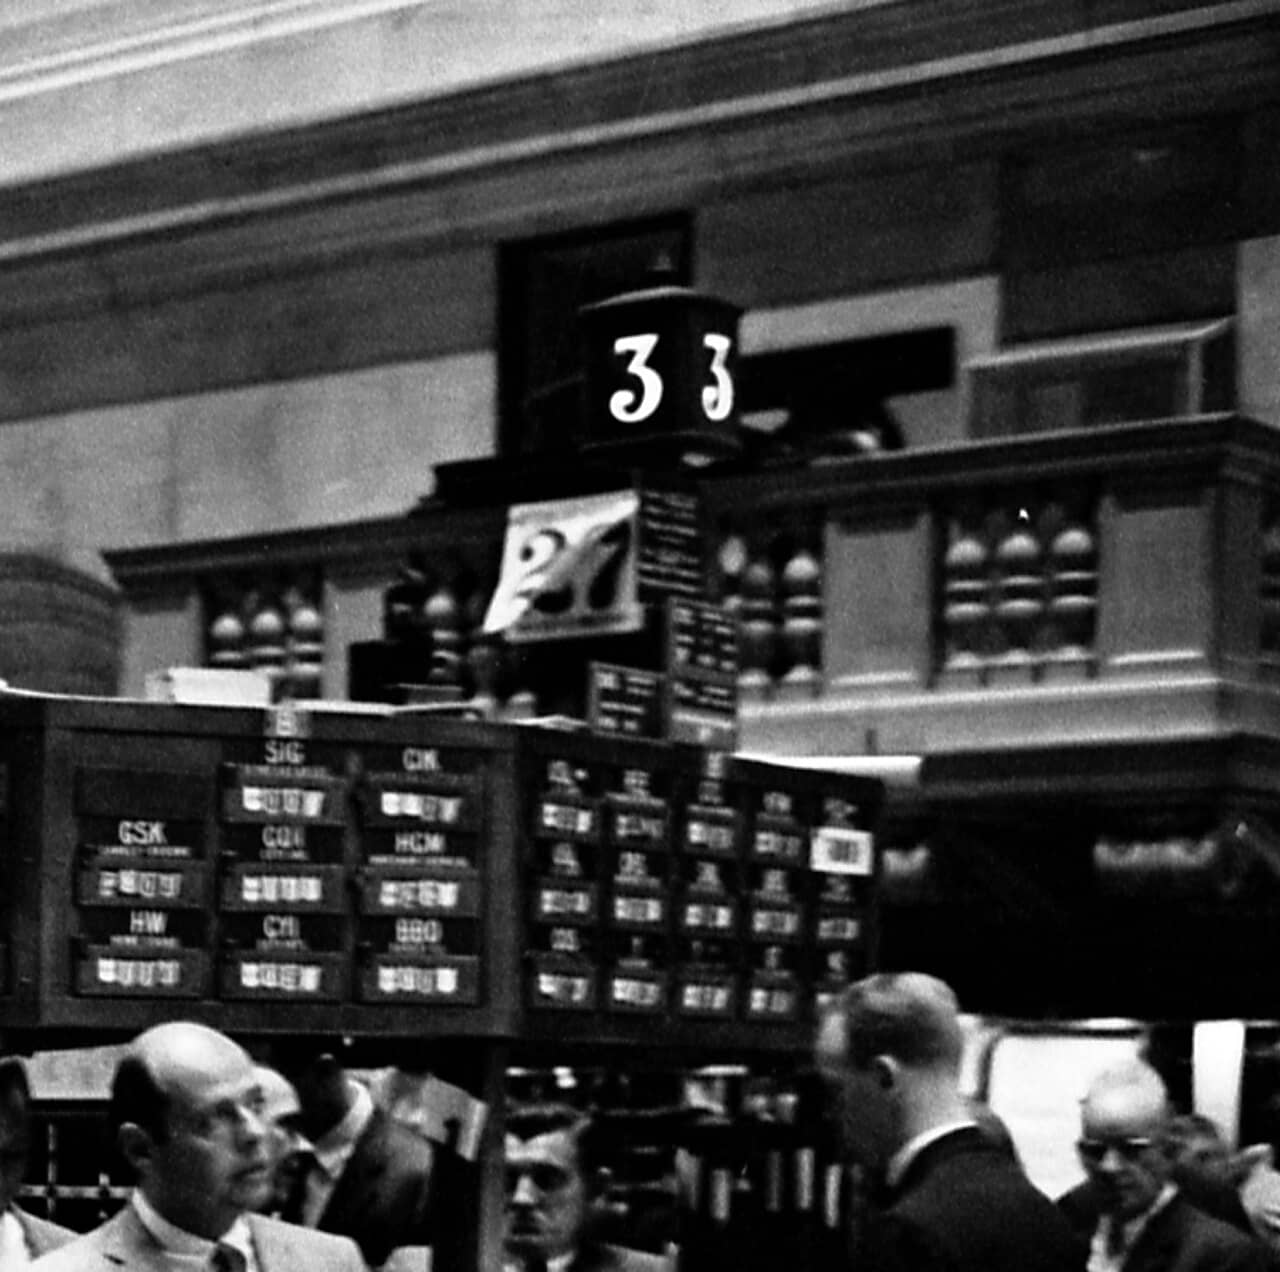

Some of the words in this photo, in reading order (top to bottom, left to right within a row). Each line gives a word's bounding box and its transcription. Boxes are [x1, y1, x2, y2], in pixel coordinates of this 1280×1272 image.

[609, 332, 664, 423] 3
[701, 332, 734, 421] 3
[264, 740, 305, 764] SIG
[130, 910, 168, 934] HW
